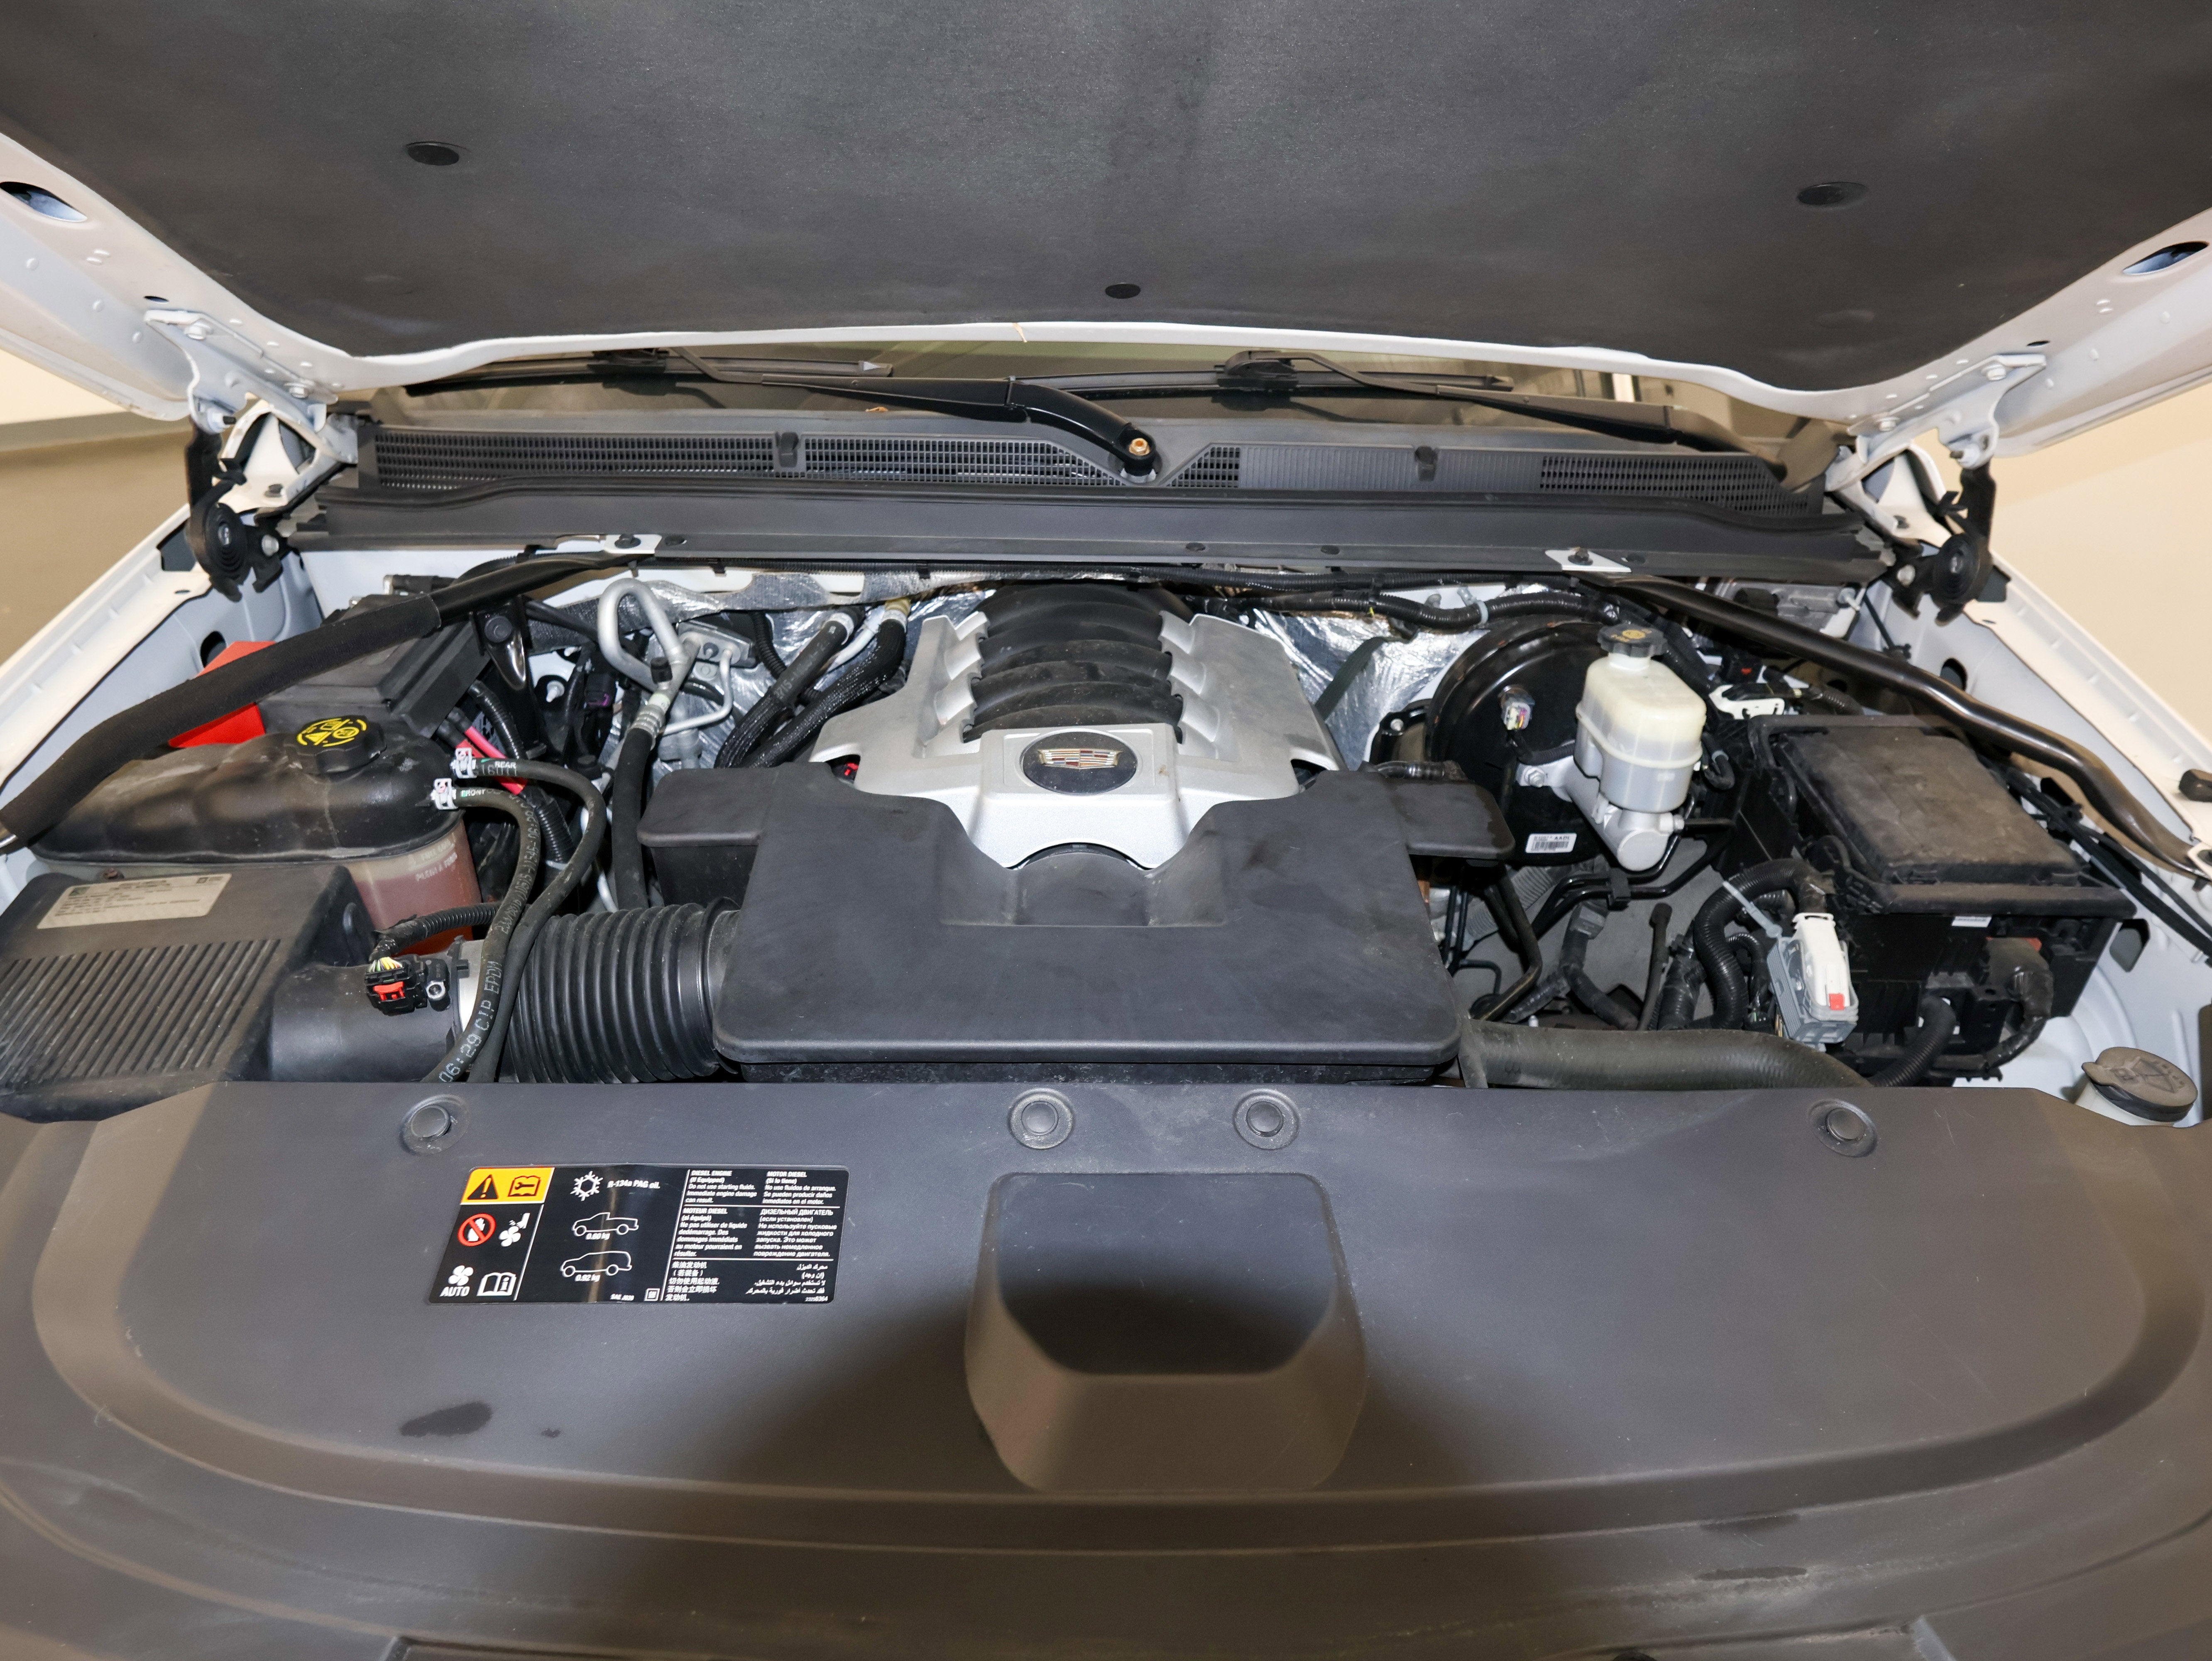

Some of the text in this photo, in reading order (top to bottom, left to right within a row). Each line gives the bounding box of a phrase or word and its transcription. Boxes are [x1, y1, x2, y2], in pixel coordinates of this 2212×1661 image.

[460, 789, 486, 797] FRONT
[484, 960, 503, 995] EPDM
[607, 1180, 632, 1188] R-134a
[633, 1180, 648, 1188] PAG
[590, 1274, 601, 1282] kg
[439, 1286, 470, 1297] AUTO
